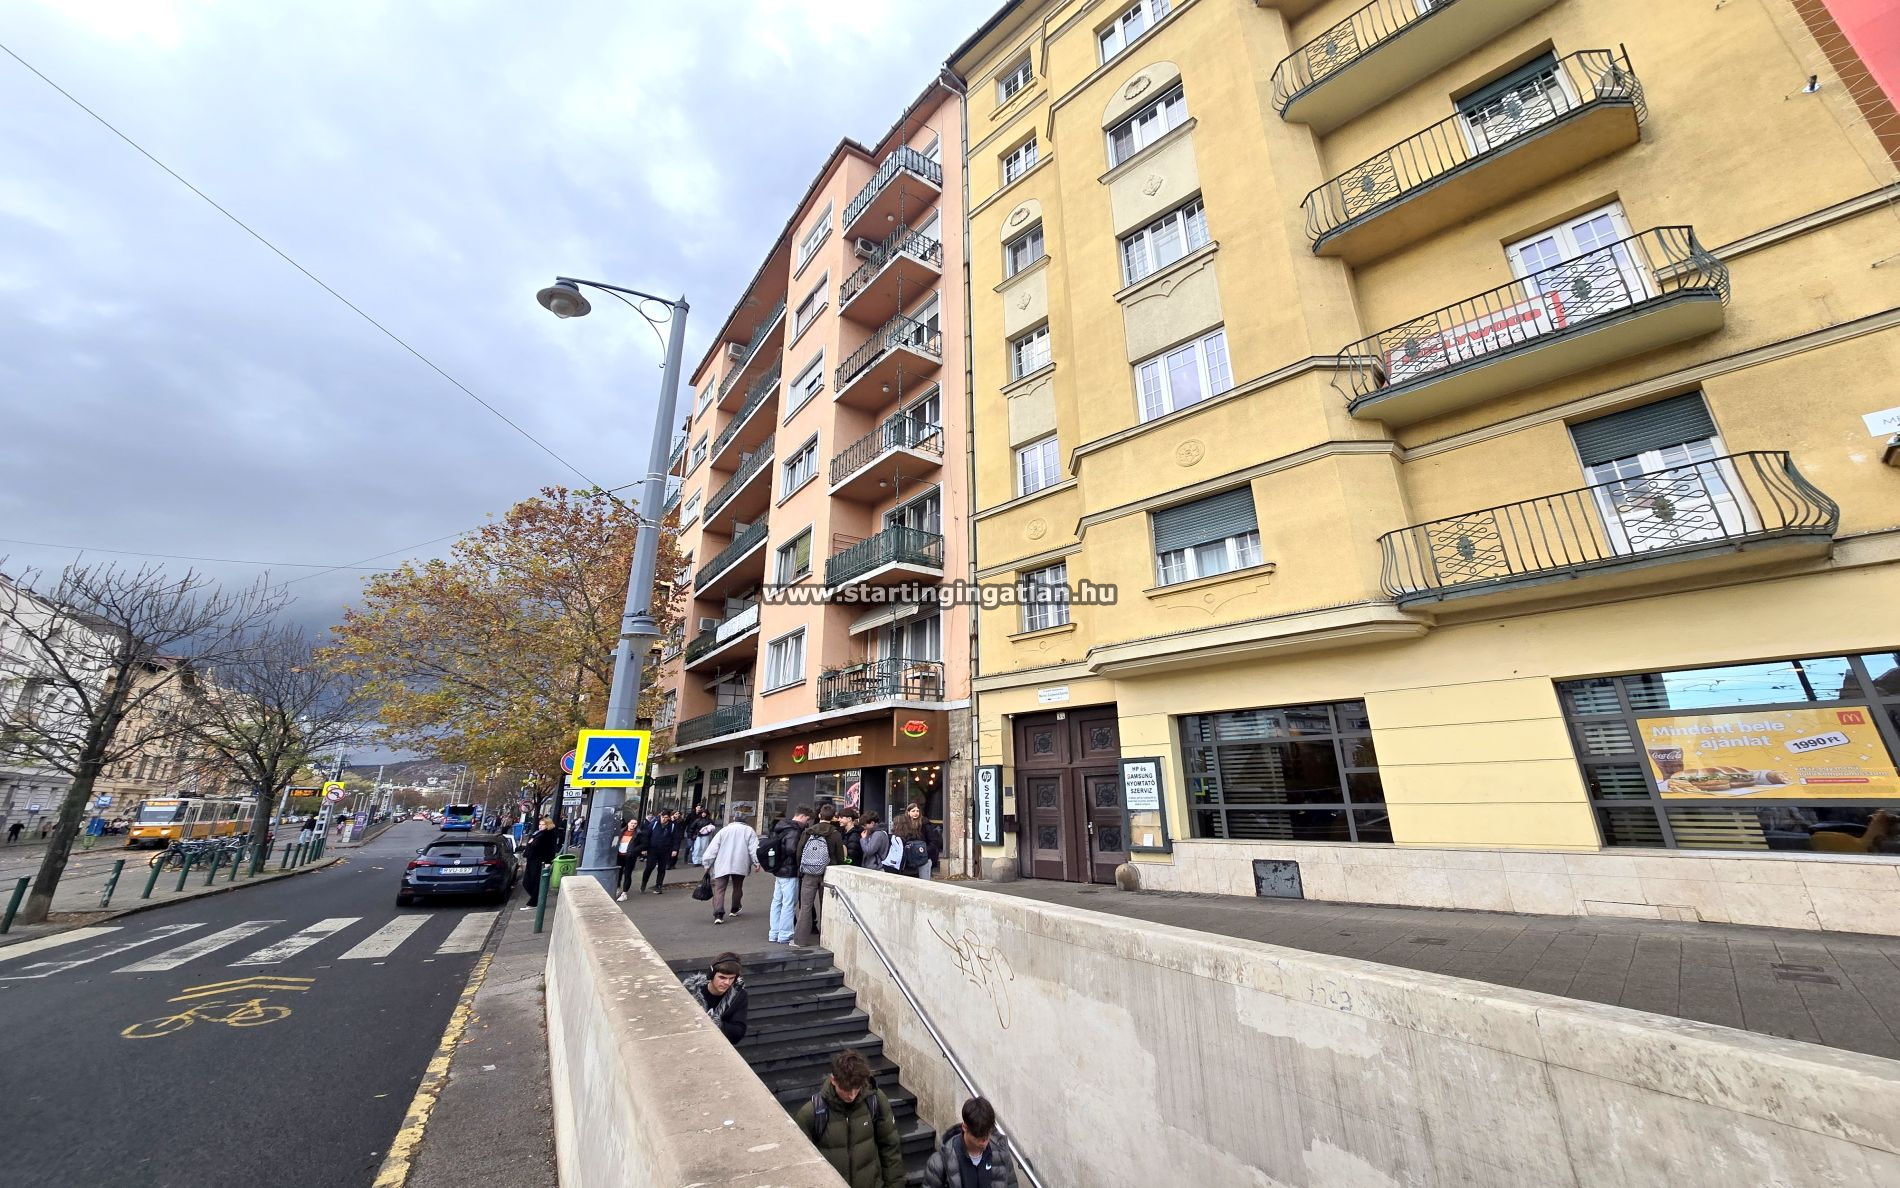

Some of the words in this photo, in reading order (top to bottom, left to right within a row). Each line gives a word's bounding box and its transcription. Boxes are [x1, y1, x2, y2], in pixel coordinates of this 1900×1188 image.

[1652, 722, 1734, 737] Mindent
[1736, 720, 1785, 733] bele
[1701, 735, 1772, 750] ajánlat
[1793, 738, 1827, 750] 1990
